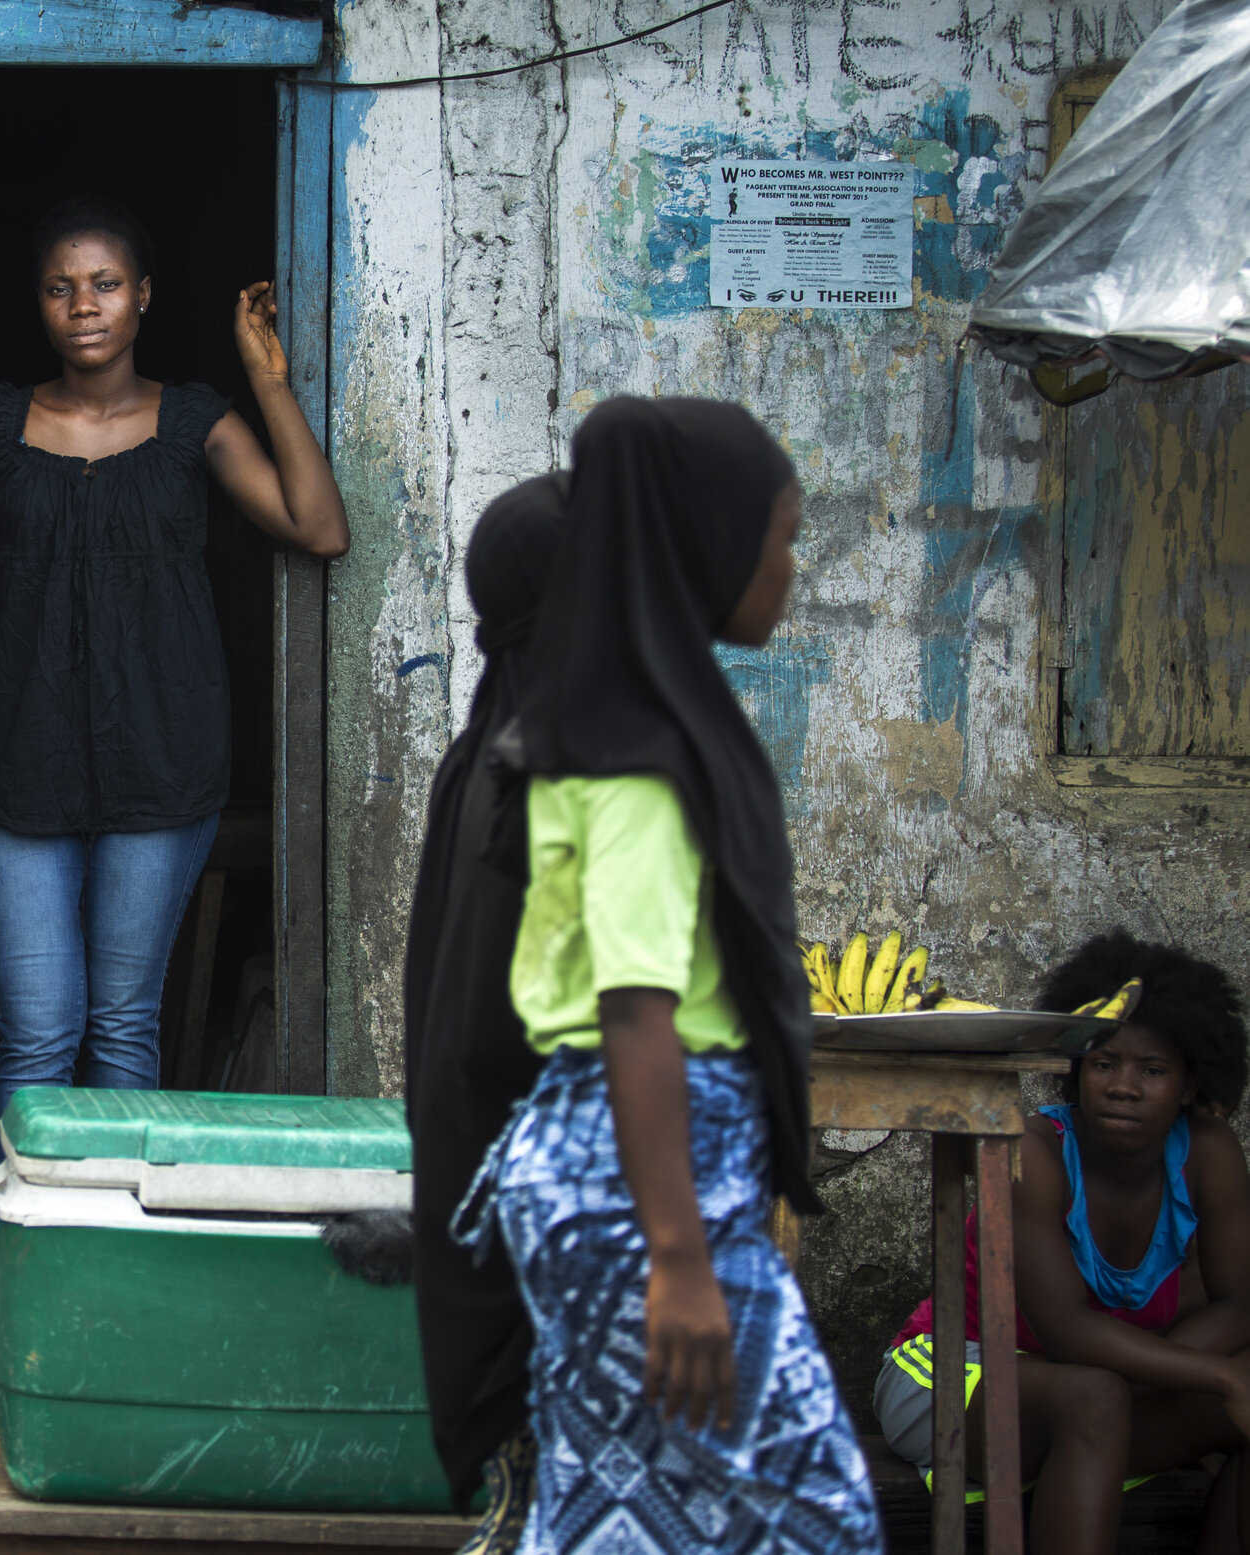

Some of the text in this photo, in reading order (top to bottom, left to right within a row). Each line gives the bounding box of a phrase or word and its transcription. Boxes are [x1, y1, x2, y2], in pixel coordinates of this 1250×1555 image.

[721, 167, 904, 183] WHO BECOMES MR. WEST POINT???
[727, 289, 897, 302] I U THERE!!!
